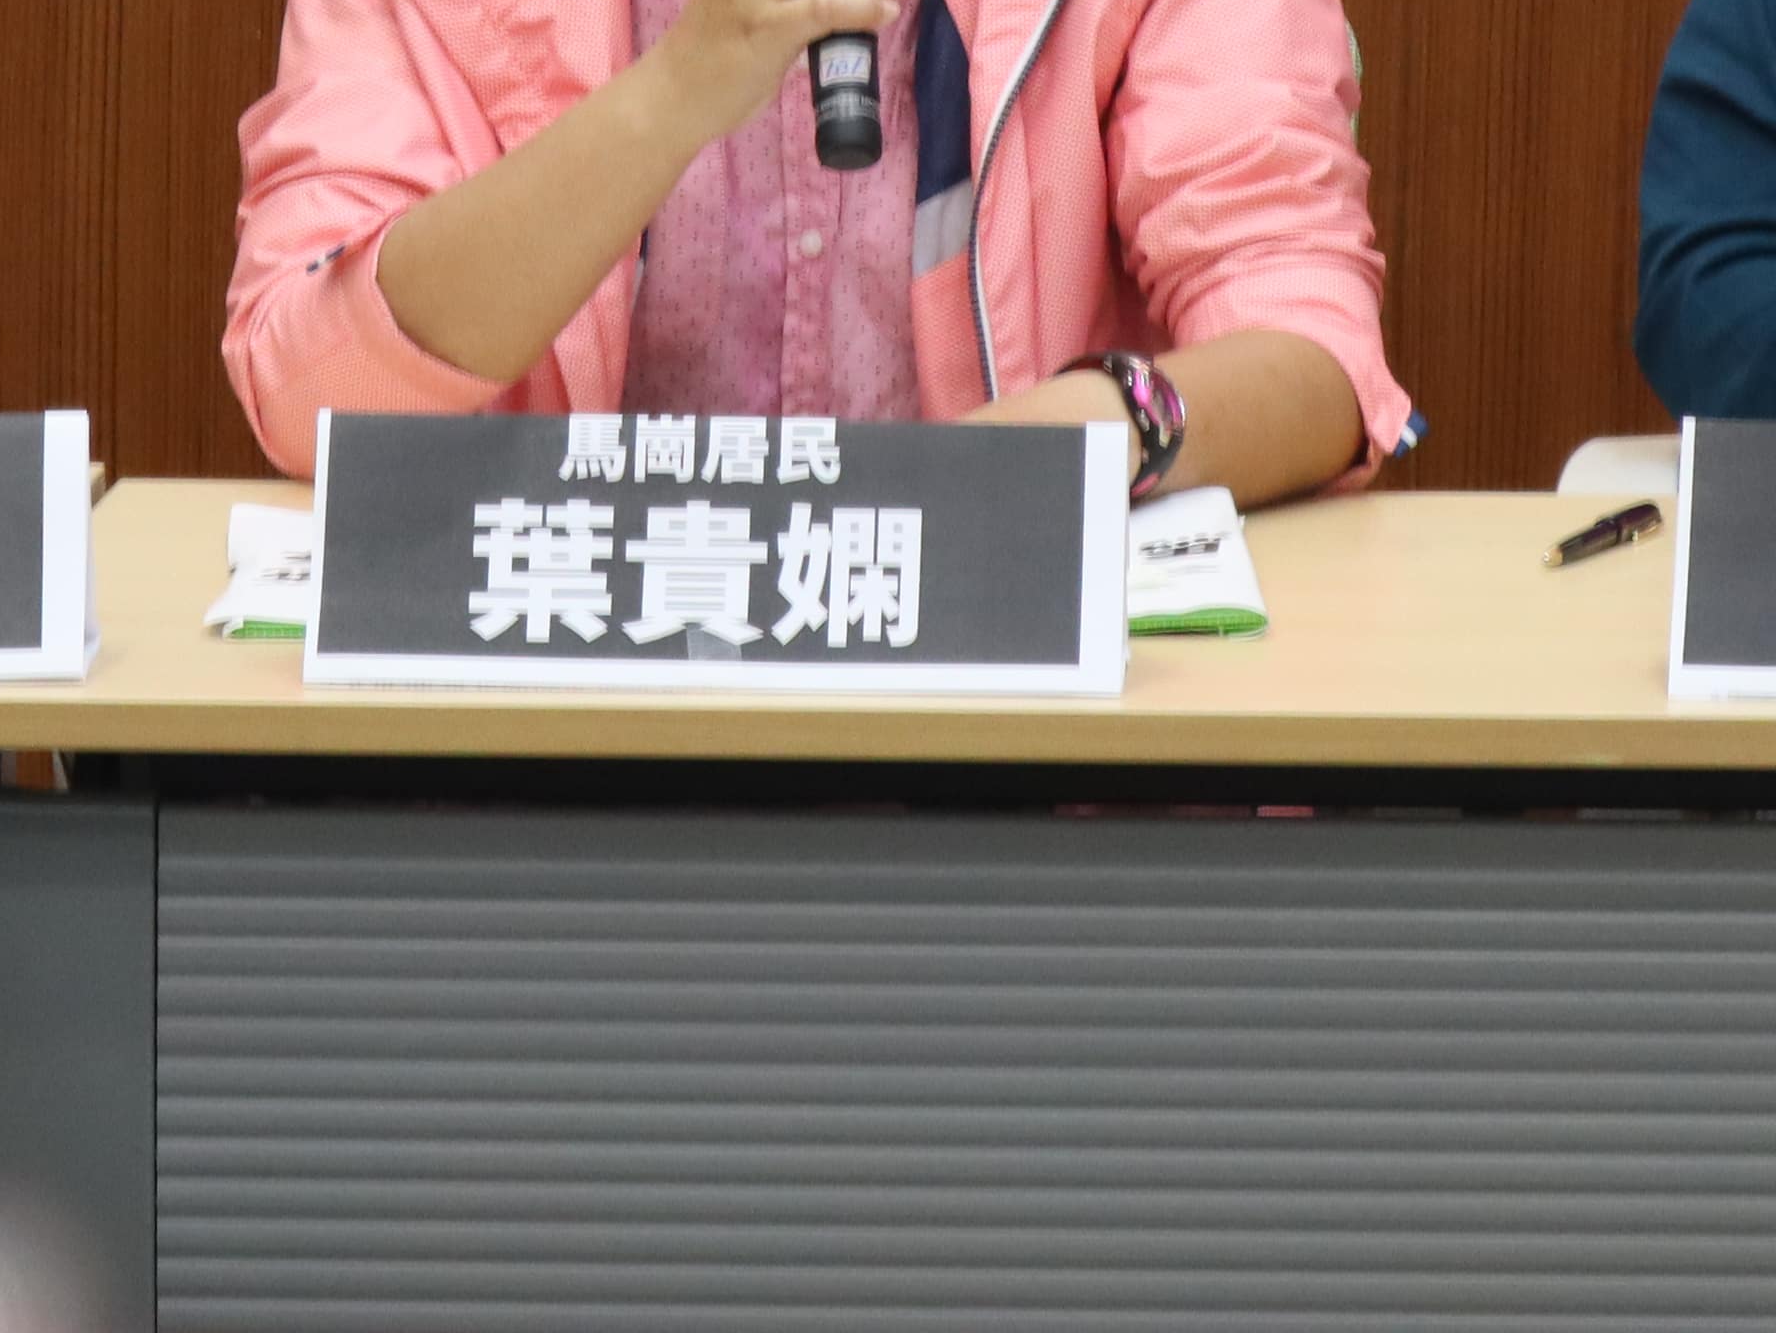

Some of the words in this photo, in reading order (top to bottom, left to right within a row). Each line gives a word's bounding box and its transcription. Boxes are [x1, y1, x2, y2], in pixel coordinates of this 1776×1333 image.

[558, 413, 842, 484] 馬崗居民
[467, 498, 923, 648] 葉貴嫻
